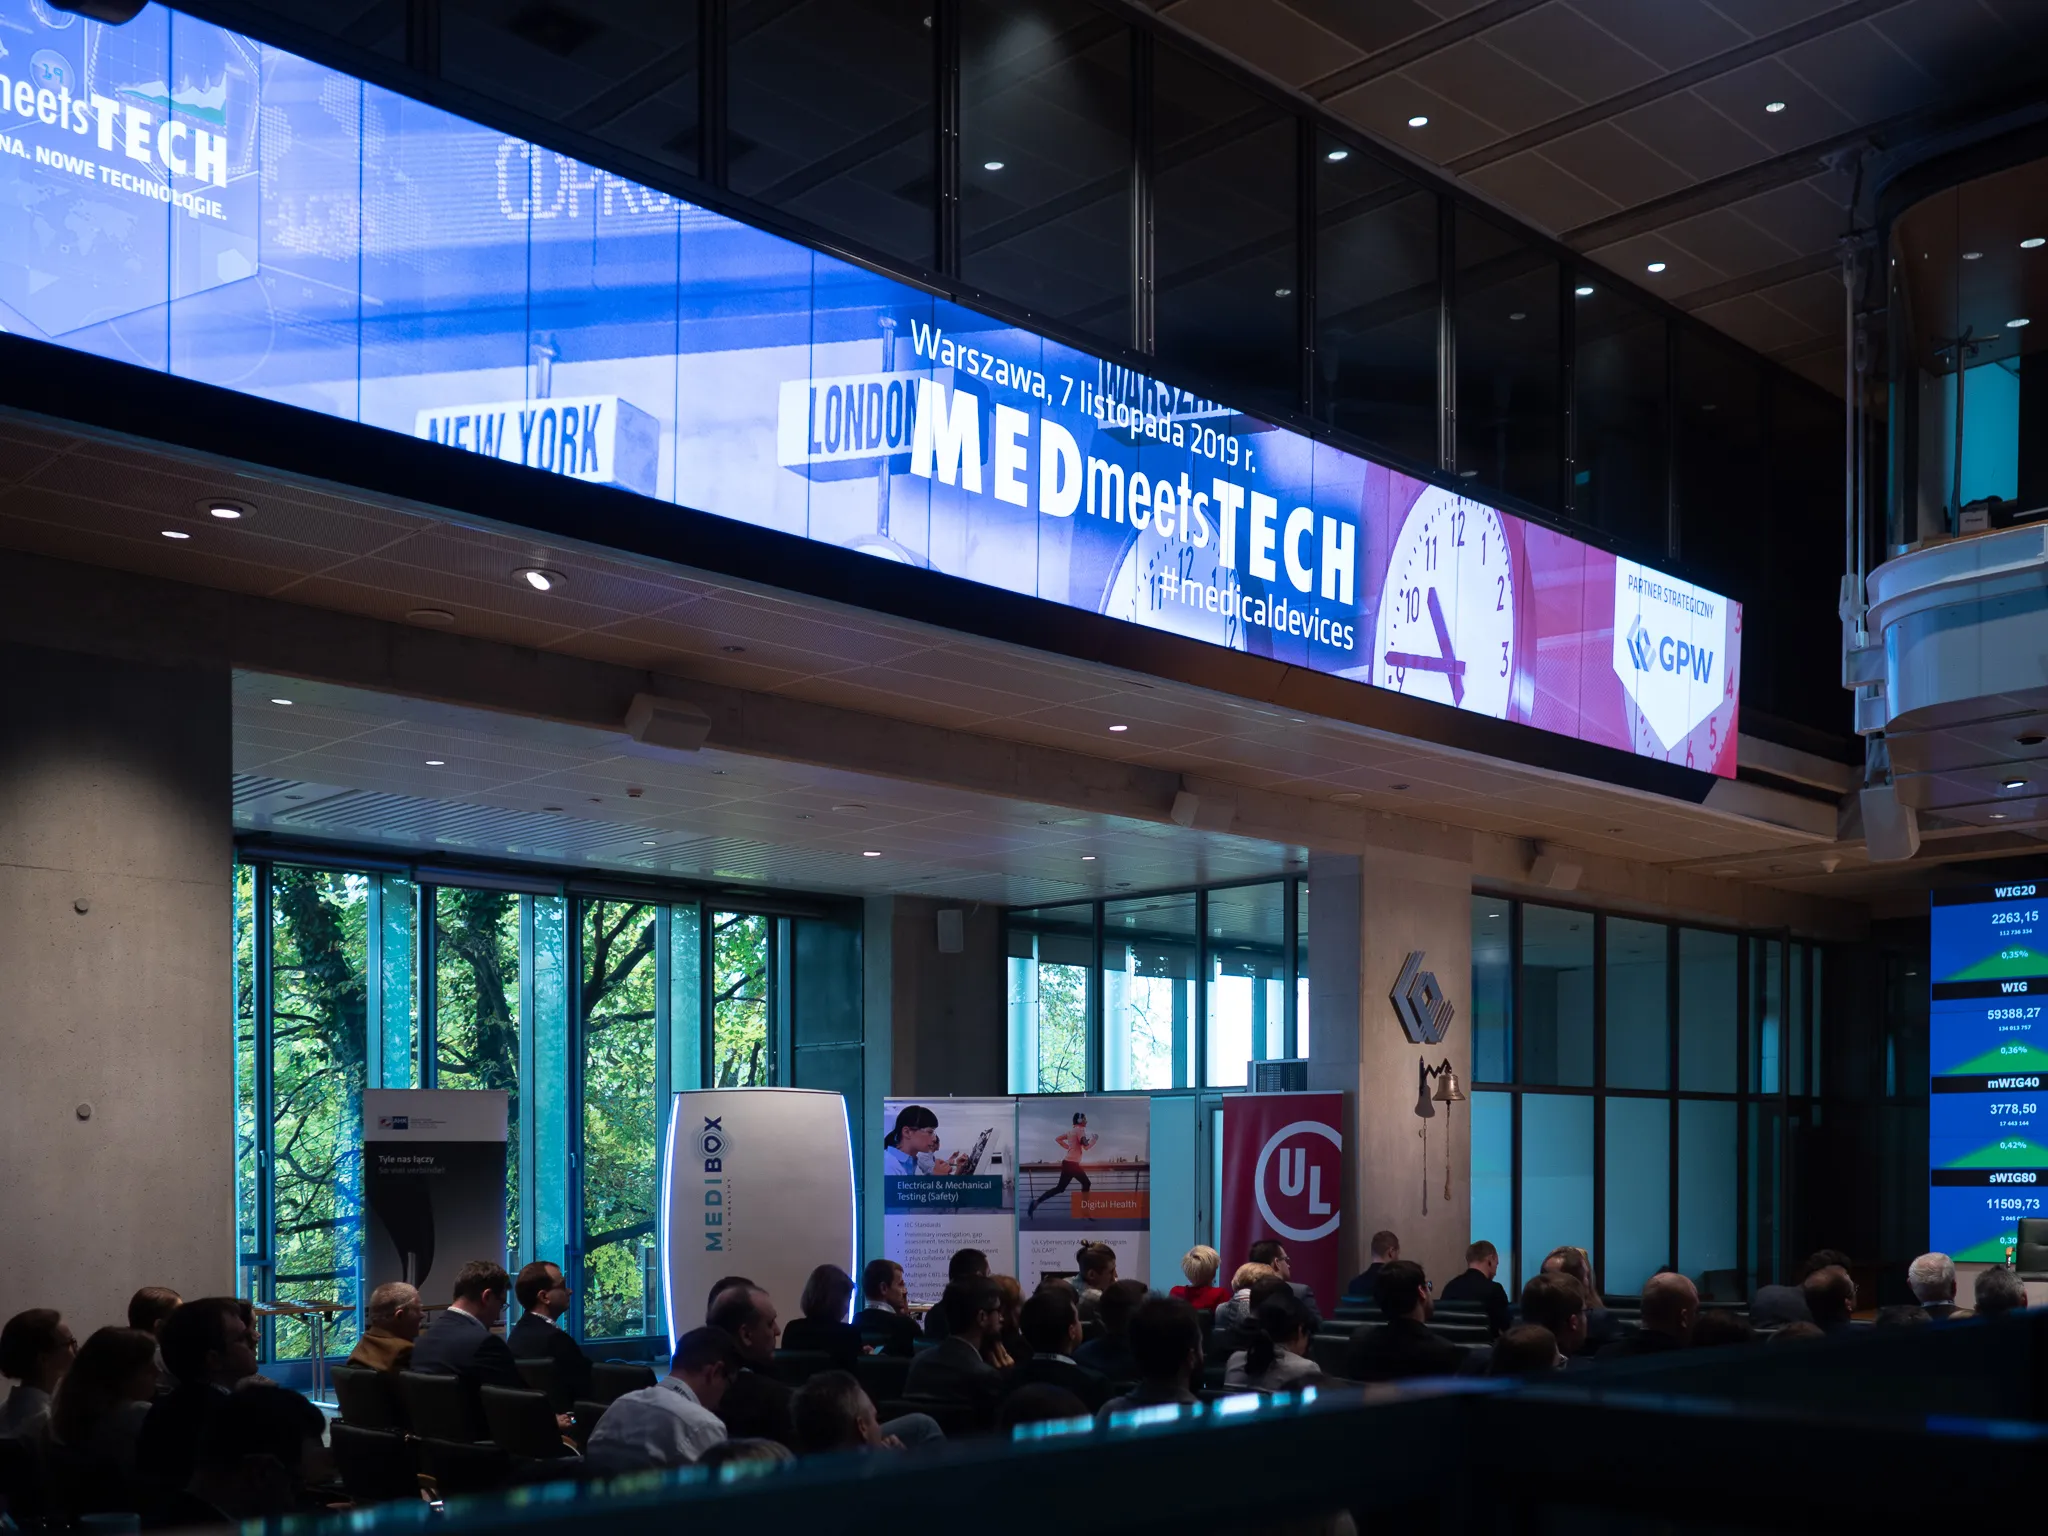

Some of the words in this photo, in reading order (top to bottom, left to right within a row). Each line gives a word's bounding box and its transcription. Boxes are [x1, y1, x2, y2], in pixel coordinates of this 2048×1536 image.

[36, 145, 95, 180] NOWE
[99, 165, 227, 221] TECHNOLOGIE.
[910, 318, 1053, 406] Warszawa,
[1060, 374, 1074, 407] 7
[1080, 380, 1185, 448] listopada
[1190, 423, 1239, 467] 2019
[1245, 448, 1257, 474] r.
[518, 403, 602, 475] YORK
[910, 376, 1356, 606] MEDmeetsTECH
[1450, 510, 1466, 548] 12
[1424, 535, 1438, 572] 11
[1480, 531, 1487, 566] 1
[1178, 546, 1194, 586] 12
[1159, 565, 1355, 651] #medicaldevices
[1405, 586, 1420, 624] 10
[1496, 575, 1505, 612] 2
[1627, 574, 1663, 602] PARTNER
[1663, 588, 1715, 620] STRATEGICZNY
[1500, 640, 1510, 678] 3
[1659, 635, 1714, 684] GPW
[1726, 667, 1734, 699] 4
[1708, 716, 1718, 751] 5
[1685, 739, 1695, 768] 6
[1994, 885, 2037, 898] WIG20
[1991, 910, 2040, 925] 2263,15
[2001, 950, 2029, 960] 0,35%
[2001, 982, 2028, 993] WIG
[1987, 1007, 2042, 1020] 59388,27
[2000, 1046, 2028, 1055] 0,36%
[1988, 1077, 2040, 1089] mWIG40
[1990, 1103, 2037, 1115] 3778,50
[378, 1155, 396, 1164] Tyle
[2000, 1142, 2027, 1150] 0,42%
[704, 1116, 723, 1252] MEDIBOX
[897, 1181, 934, 1190] Electrical
[935, 1181, 943, 1190] &
[945, 1181, 992, 1190] Mechanical
[1278, 1147, 1331, 1215] UL
[1989, 1172, 2037, 1183] sWIG80
[897, 1192, 927, 1202] Testing
[928, 1192, 959, 1202] (Safety)
[1081, 1200, 1108, 1210] Digital
[1109, 1200, 1137, 1209] Health
[1986, 1198, 2040, 1210] 11509,73
